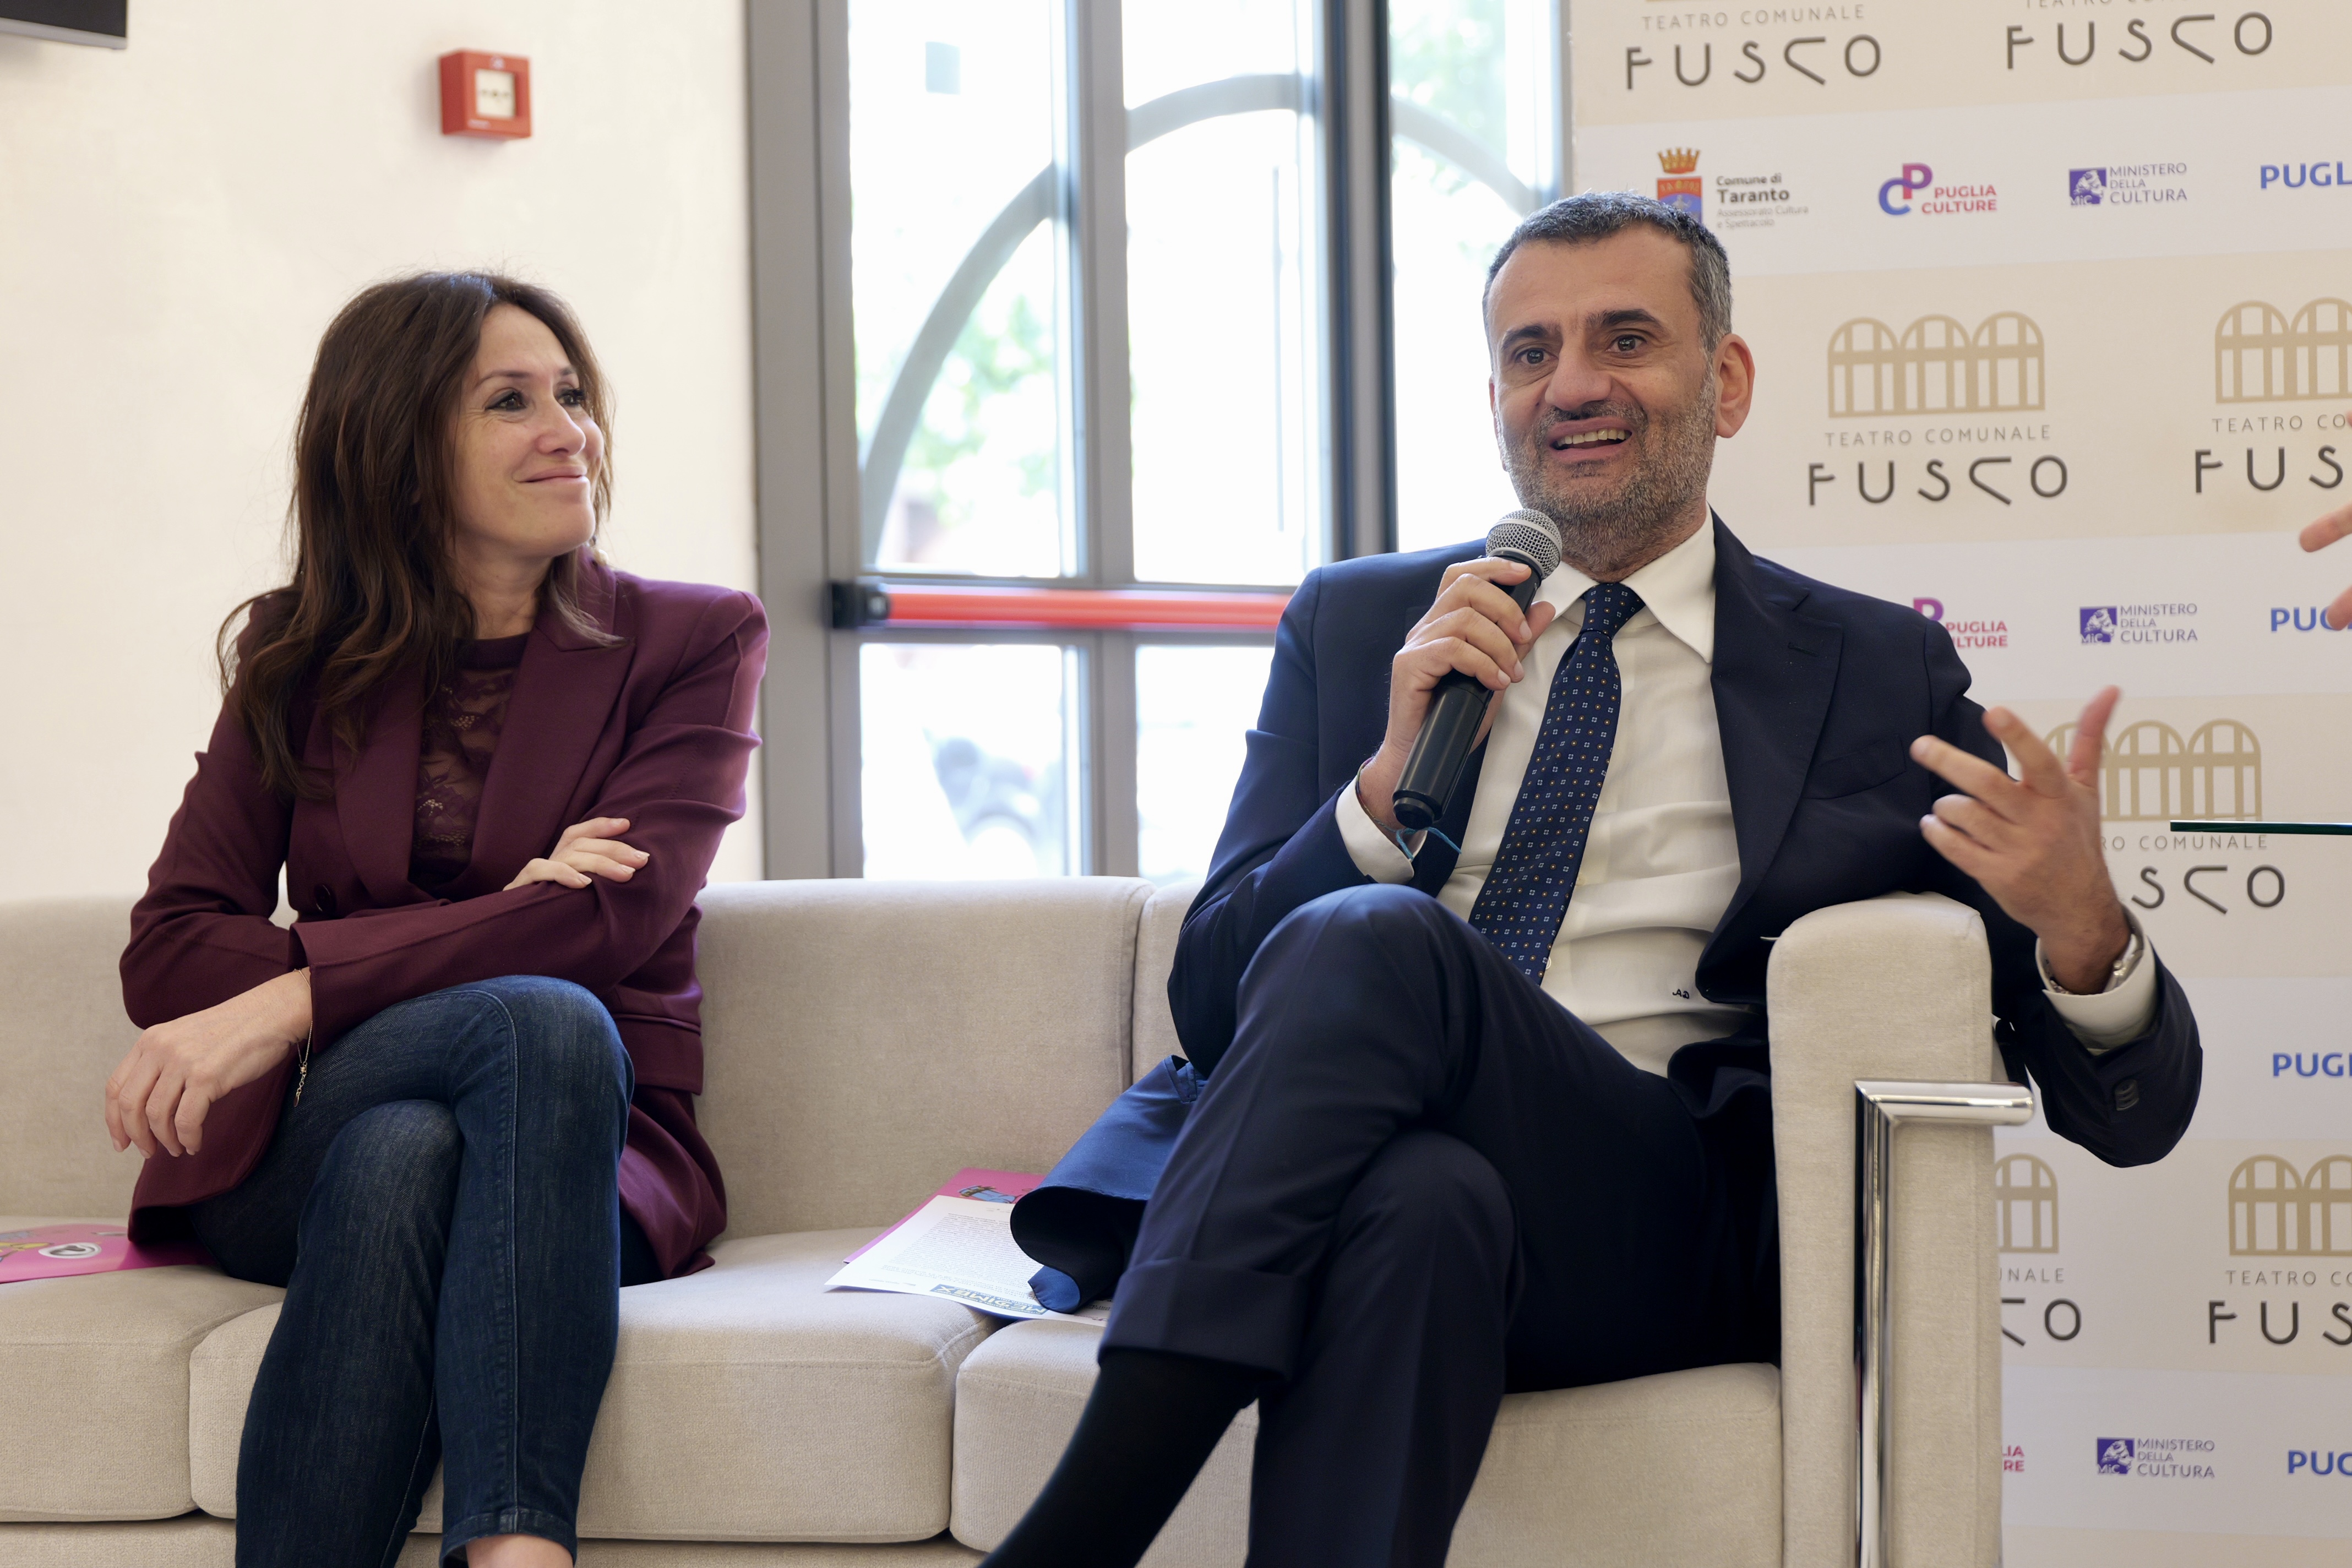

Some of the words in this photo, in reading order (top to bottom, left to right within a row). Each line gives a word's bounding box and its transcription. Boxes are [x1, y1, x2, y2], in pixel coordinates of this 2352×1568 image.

[1642, 12, 1728, 30] TEATRO
[1741, 4, 1865, 25] COMUNALE
[2007, 12, 2272, 69] FUSCO
[1626, 34, 1881, 89] FUSCO
[2110, 162, 2187, 177] MINISTERO
[1716, 176, 1767, 186] Comune
[1771, 173, 1782, 183] di
[2110, 178, 2146, 188] DELLA
[1717, 189, 1790, 203] Taranto
[1934, 184, 1997, 198] PUGLIA
[2110, 188, 2187, 204] CULTURA
[1775, 205, 1809, 215] Cultura
[1921, 199, 1997, 214] CULTURE
[2212, 415, 2302, 432] TEATRO
[1825, 430, 1912, 447] TEATRO
[1925, 424, 2050, 443] COMUNALE
[1809, 454, 2068, 506] FUSCO
[2121, 603, 2197, 616] MINISTERO
[1946, 620, 2007, 633] PUGLIA
[2121, 618, 2157, 628] DELLA
[2121, 629, 2198, 643] CULTURA
[2139, 834, 2267, 849] COMUNALE
[2131, 864, 2285, 914] SCO
[2000, 1268, 2064, 1282] NALE
[2226, 1270, 2316, 1284] TEATRO
[2138, 1438, 2215, 1451] MINISTERO
[2138, 1451, 2174, 1462] DELLA
[2137, 1463, 2215, 1478] CULTURA
